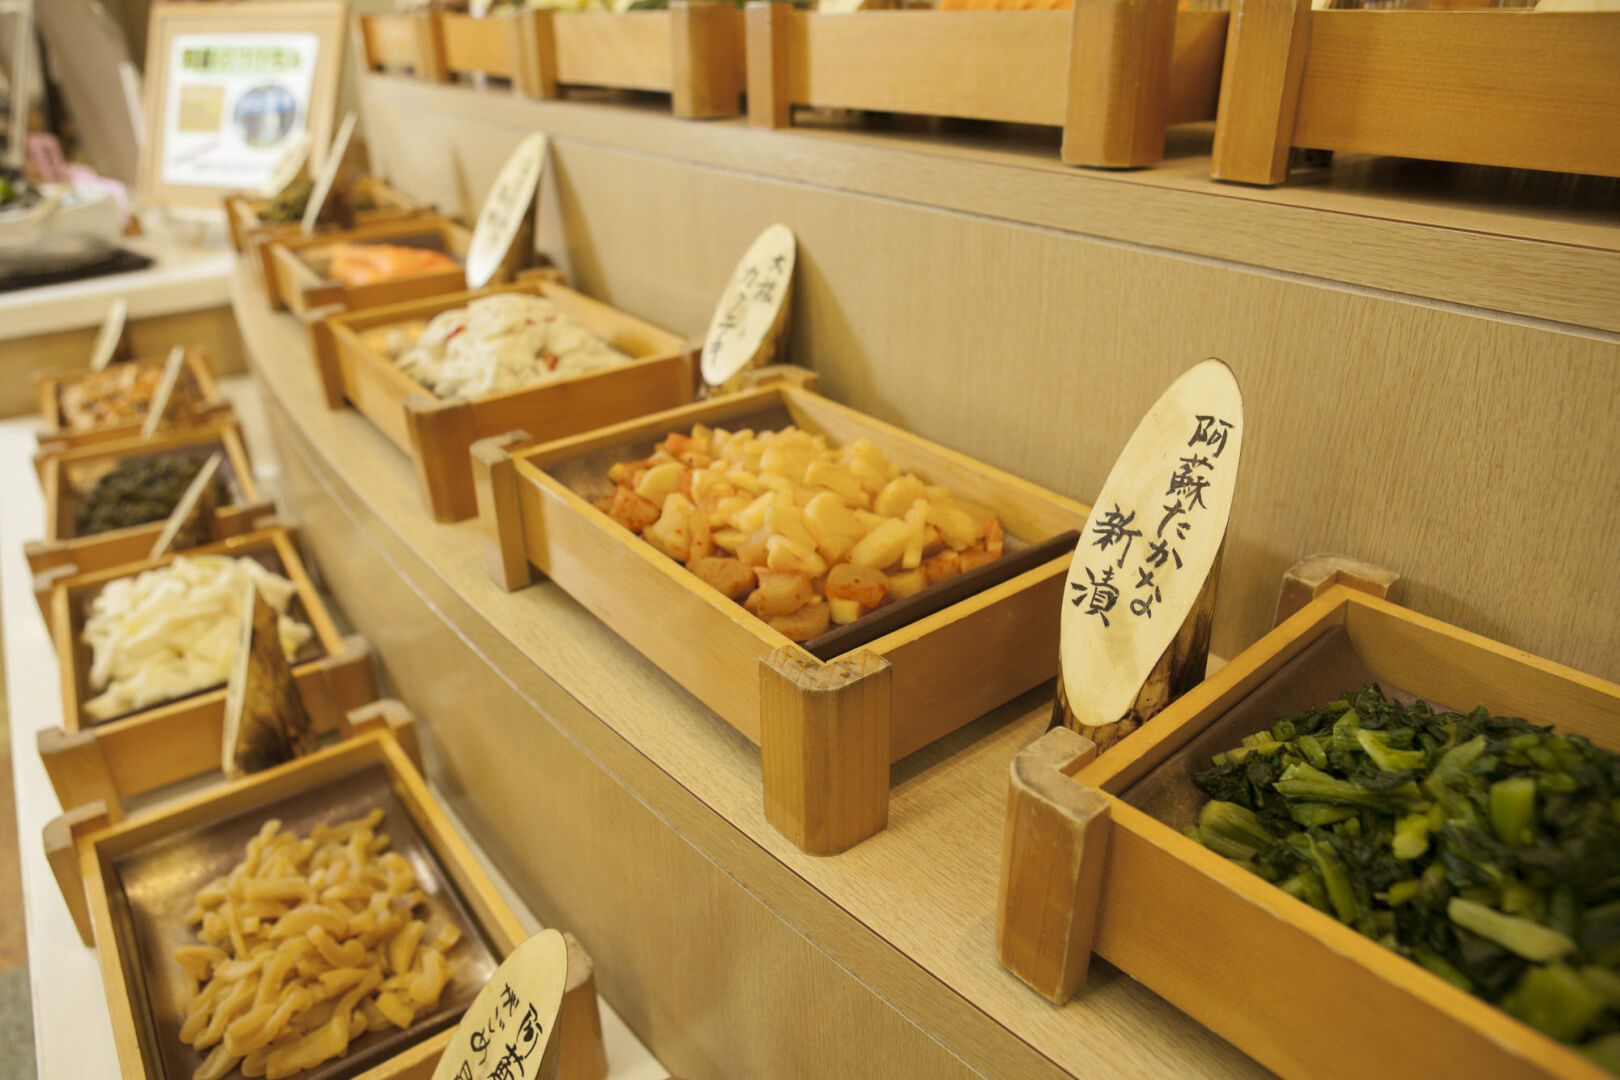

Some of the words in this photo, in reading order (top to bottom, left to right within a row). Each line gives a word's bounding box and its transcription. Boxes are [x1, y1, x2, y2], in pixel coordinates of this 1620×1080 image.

[1071, 503, 1143, 628] 新漬
[1130, 414, 1234, 620] 阿蘇たかな
